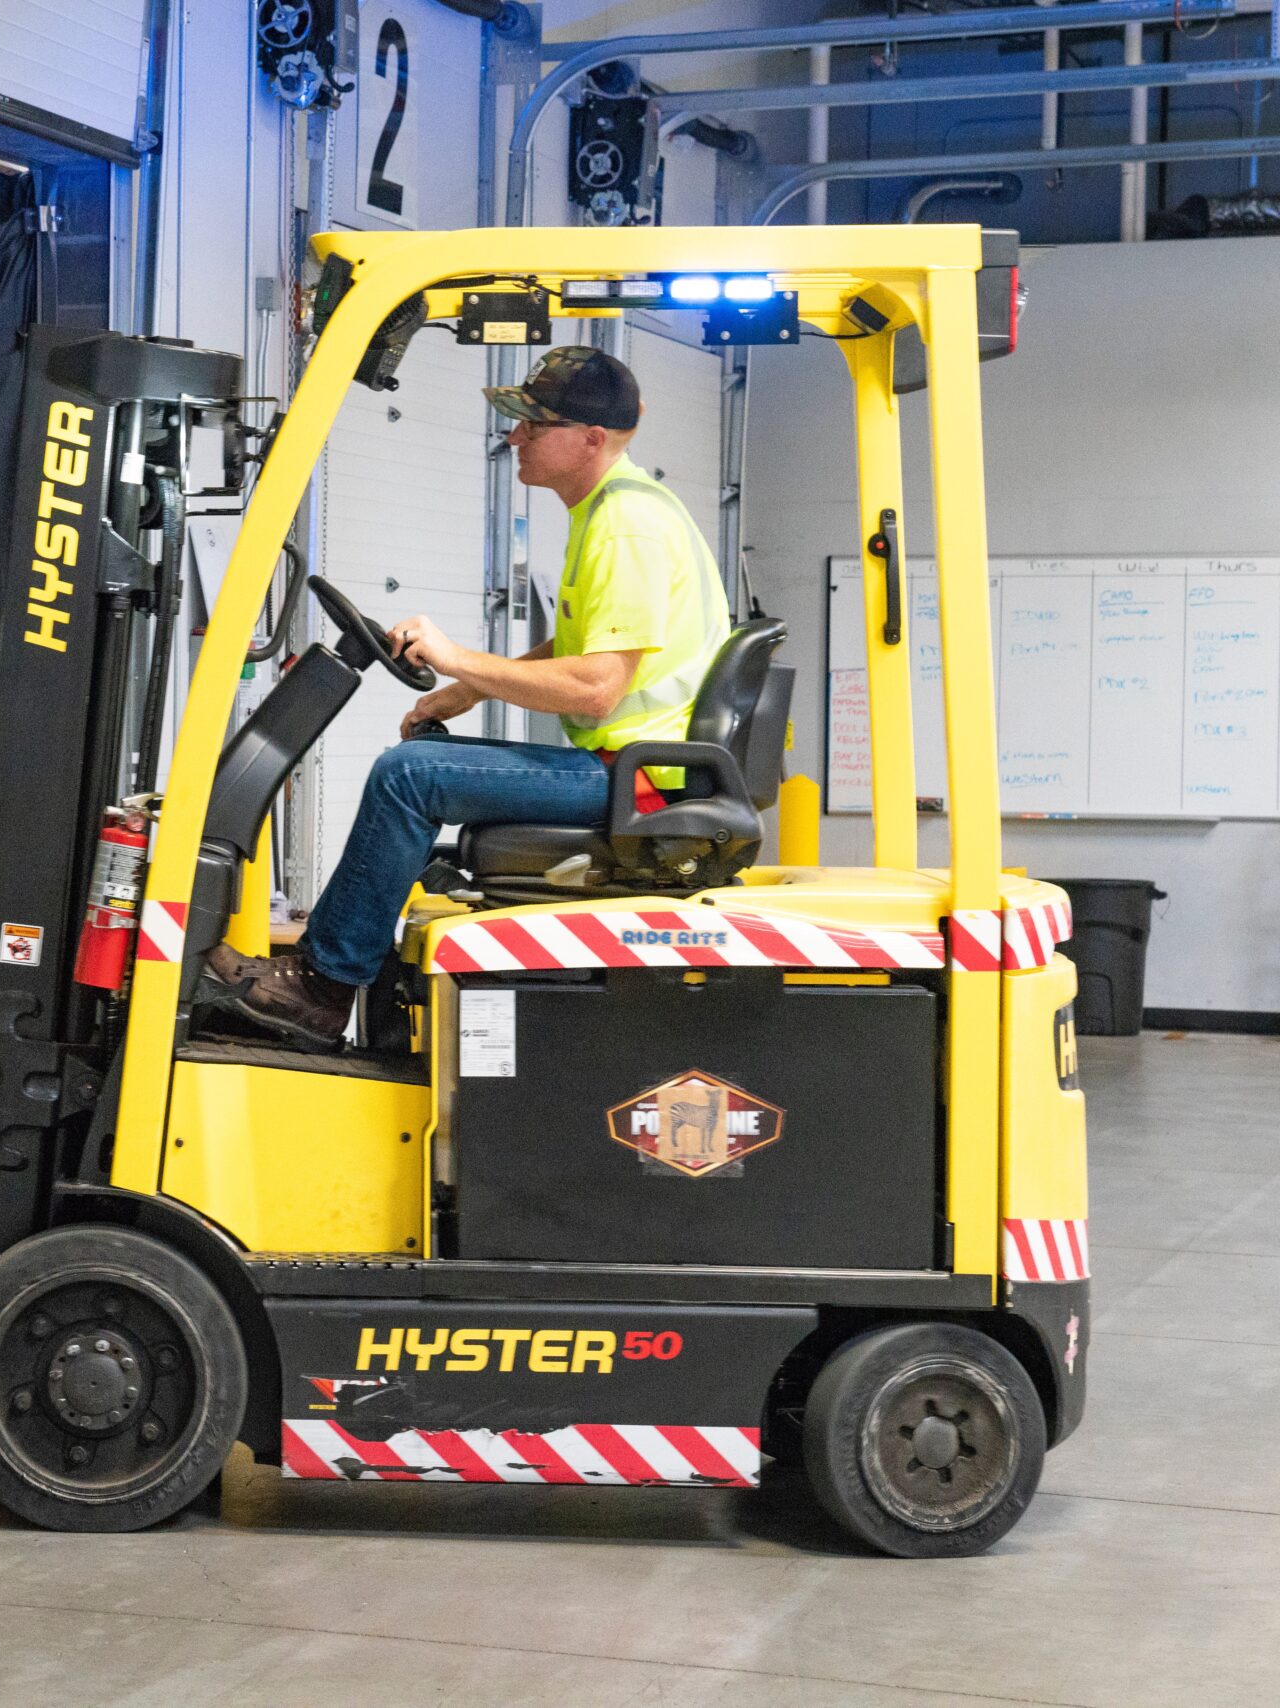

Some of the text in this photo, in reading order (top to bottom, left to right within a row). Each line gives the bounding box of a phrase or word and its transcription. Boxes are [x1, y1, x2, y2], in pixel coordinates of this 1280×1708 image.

[367, 18, 409, 216] 2
[24, 401, 94, 653] HYSTER
[1207, 560, 1258, 572] Thurs
[622, 930, 672, 945] RIDE
[355, 1328, 683, 1374] HYSTER 50
